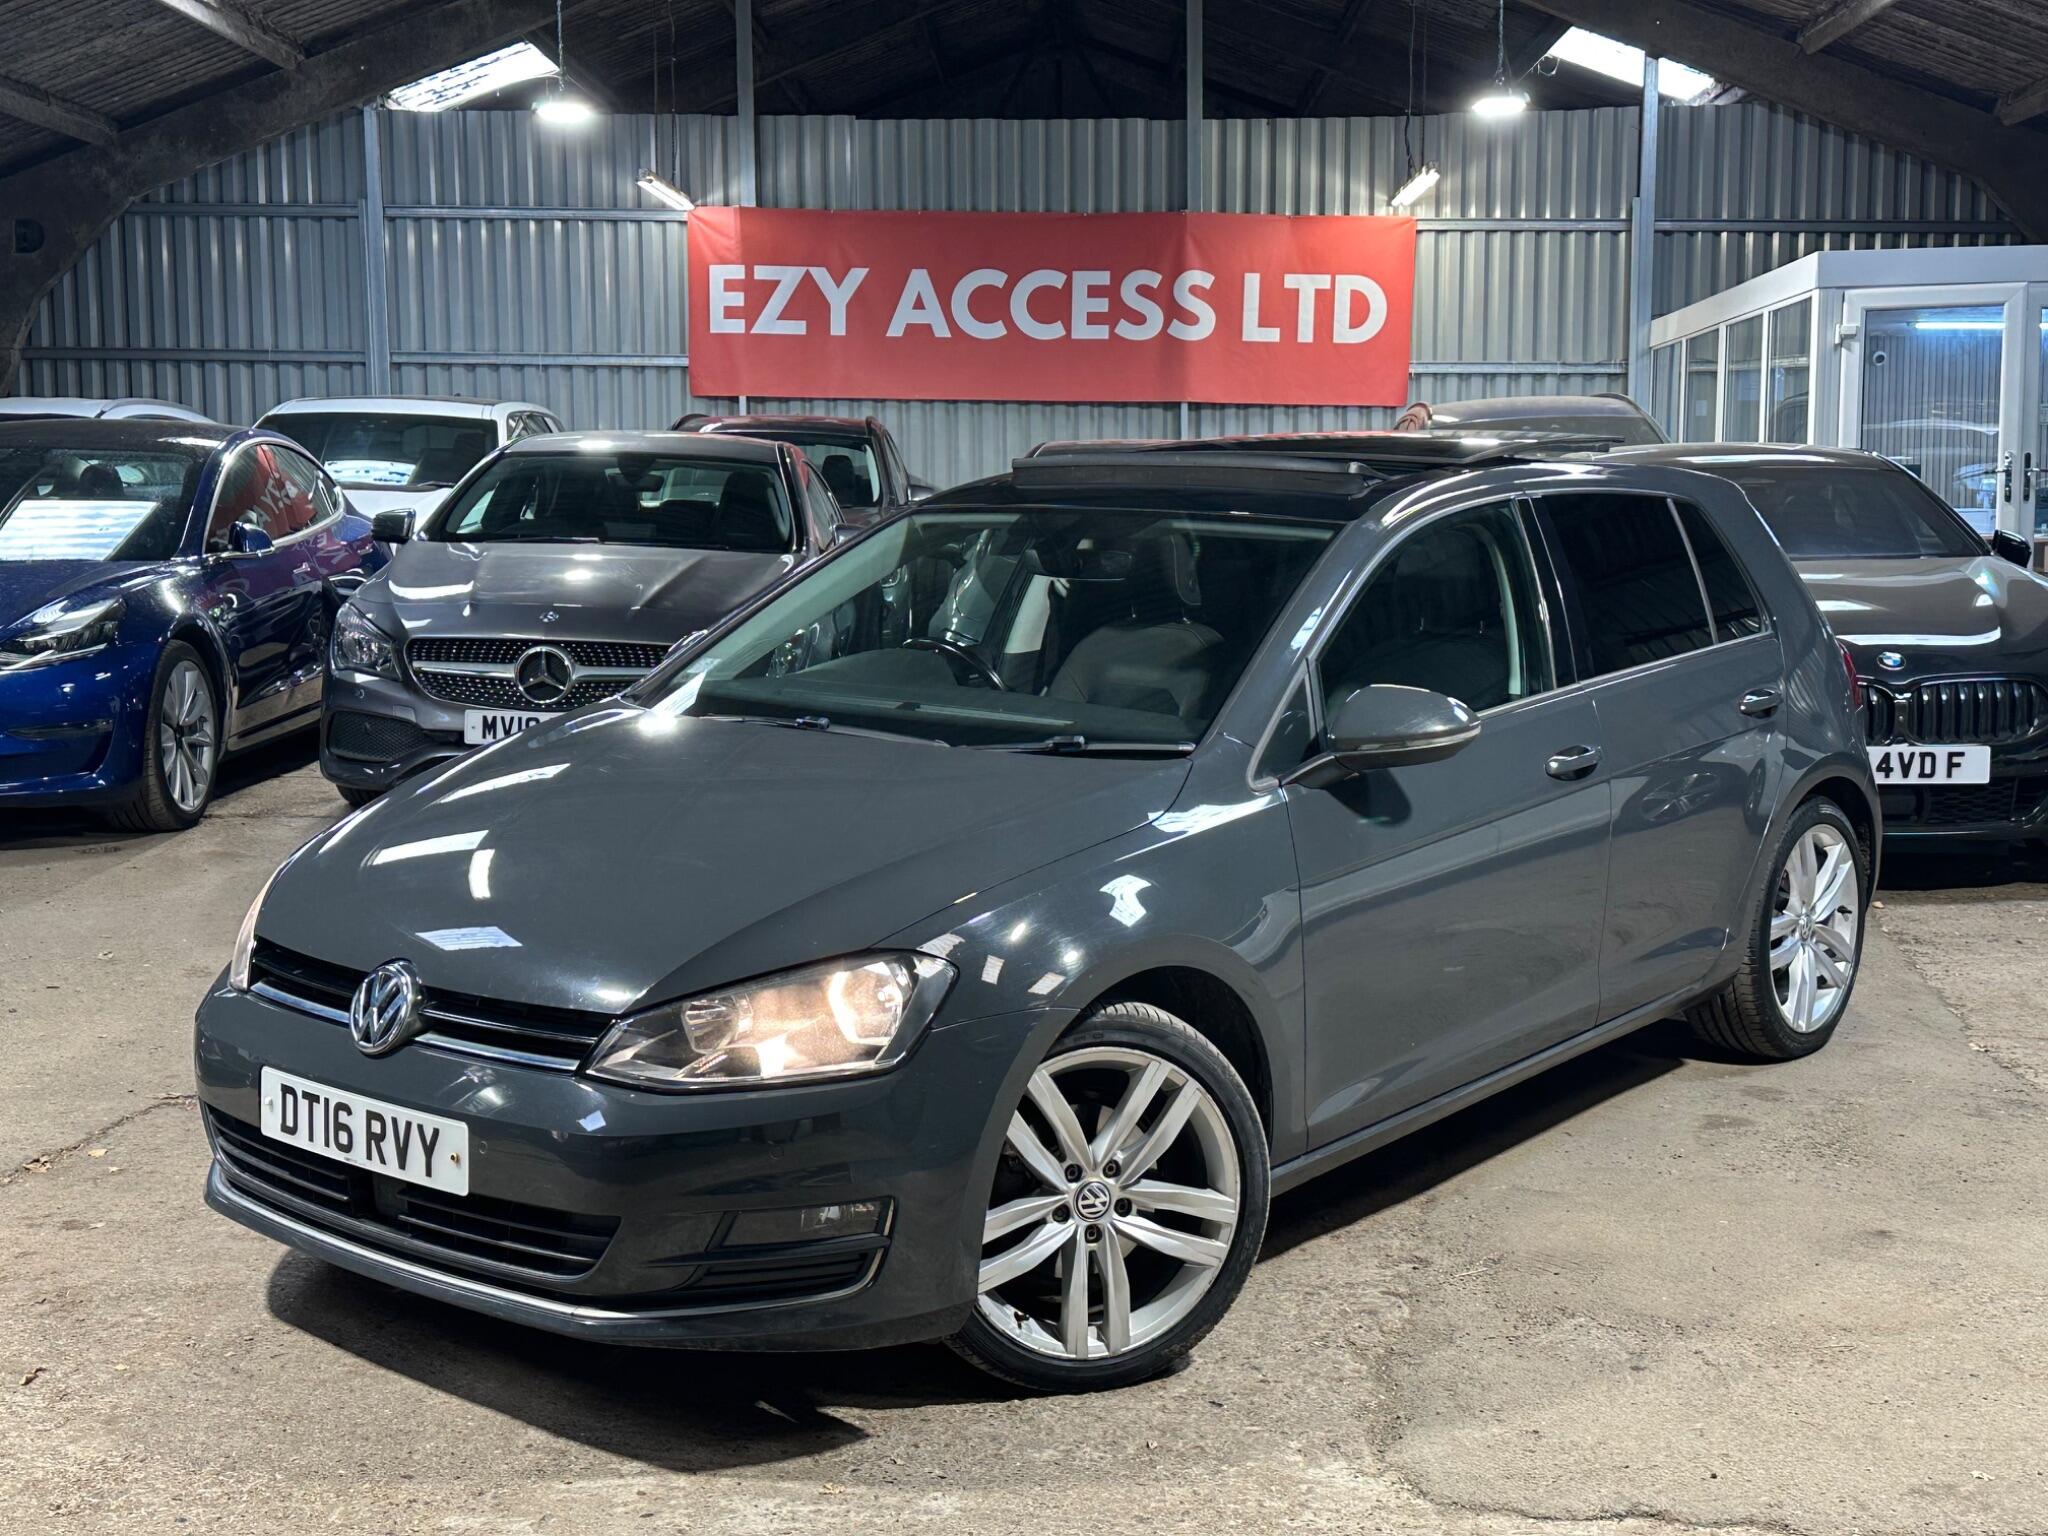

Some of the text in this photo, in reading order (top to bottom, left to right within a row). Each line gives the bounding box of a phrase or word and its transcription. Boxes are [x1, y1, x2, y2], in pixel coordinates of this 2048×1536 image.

[708, 264, 1388, 345] EZY ACCESS LTD
[279, 1083, 440, 1178] DT16 RVY
